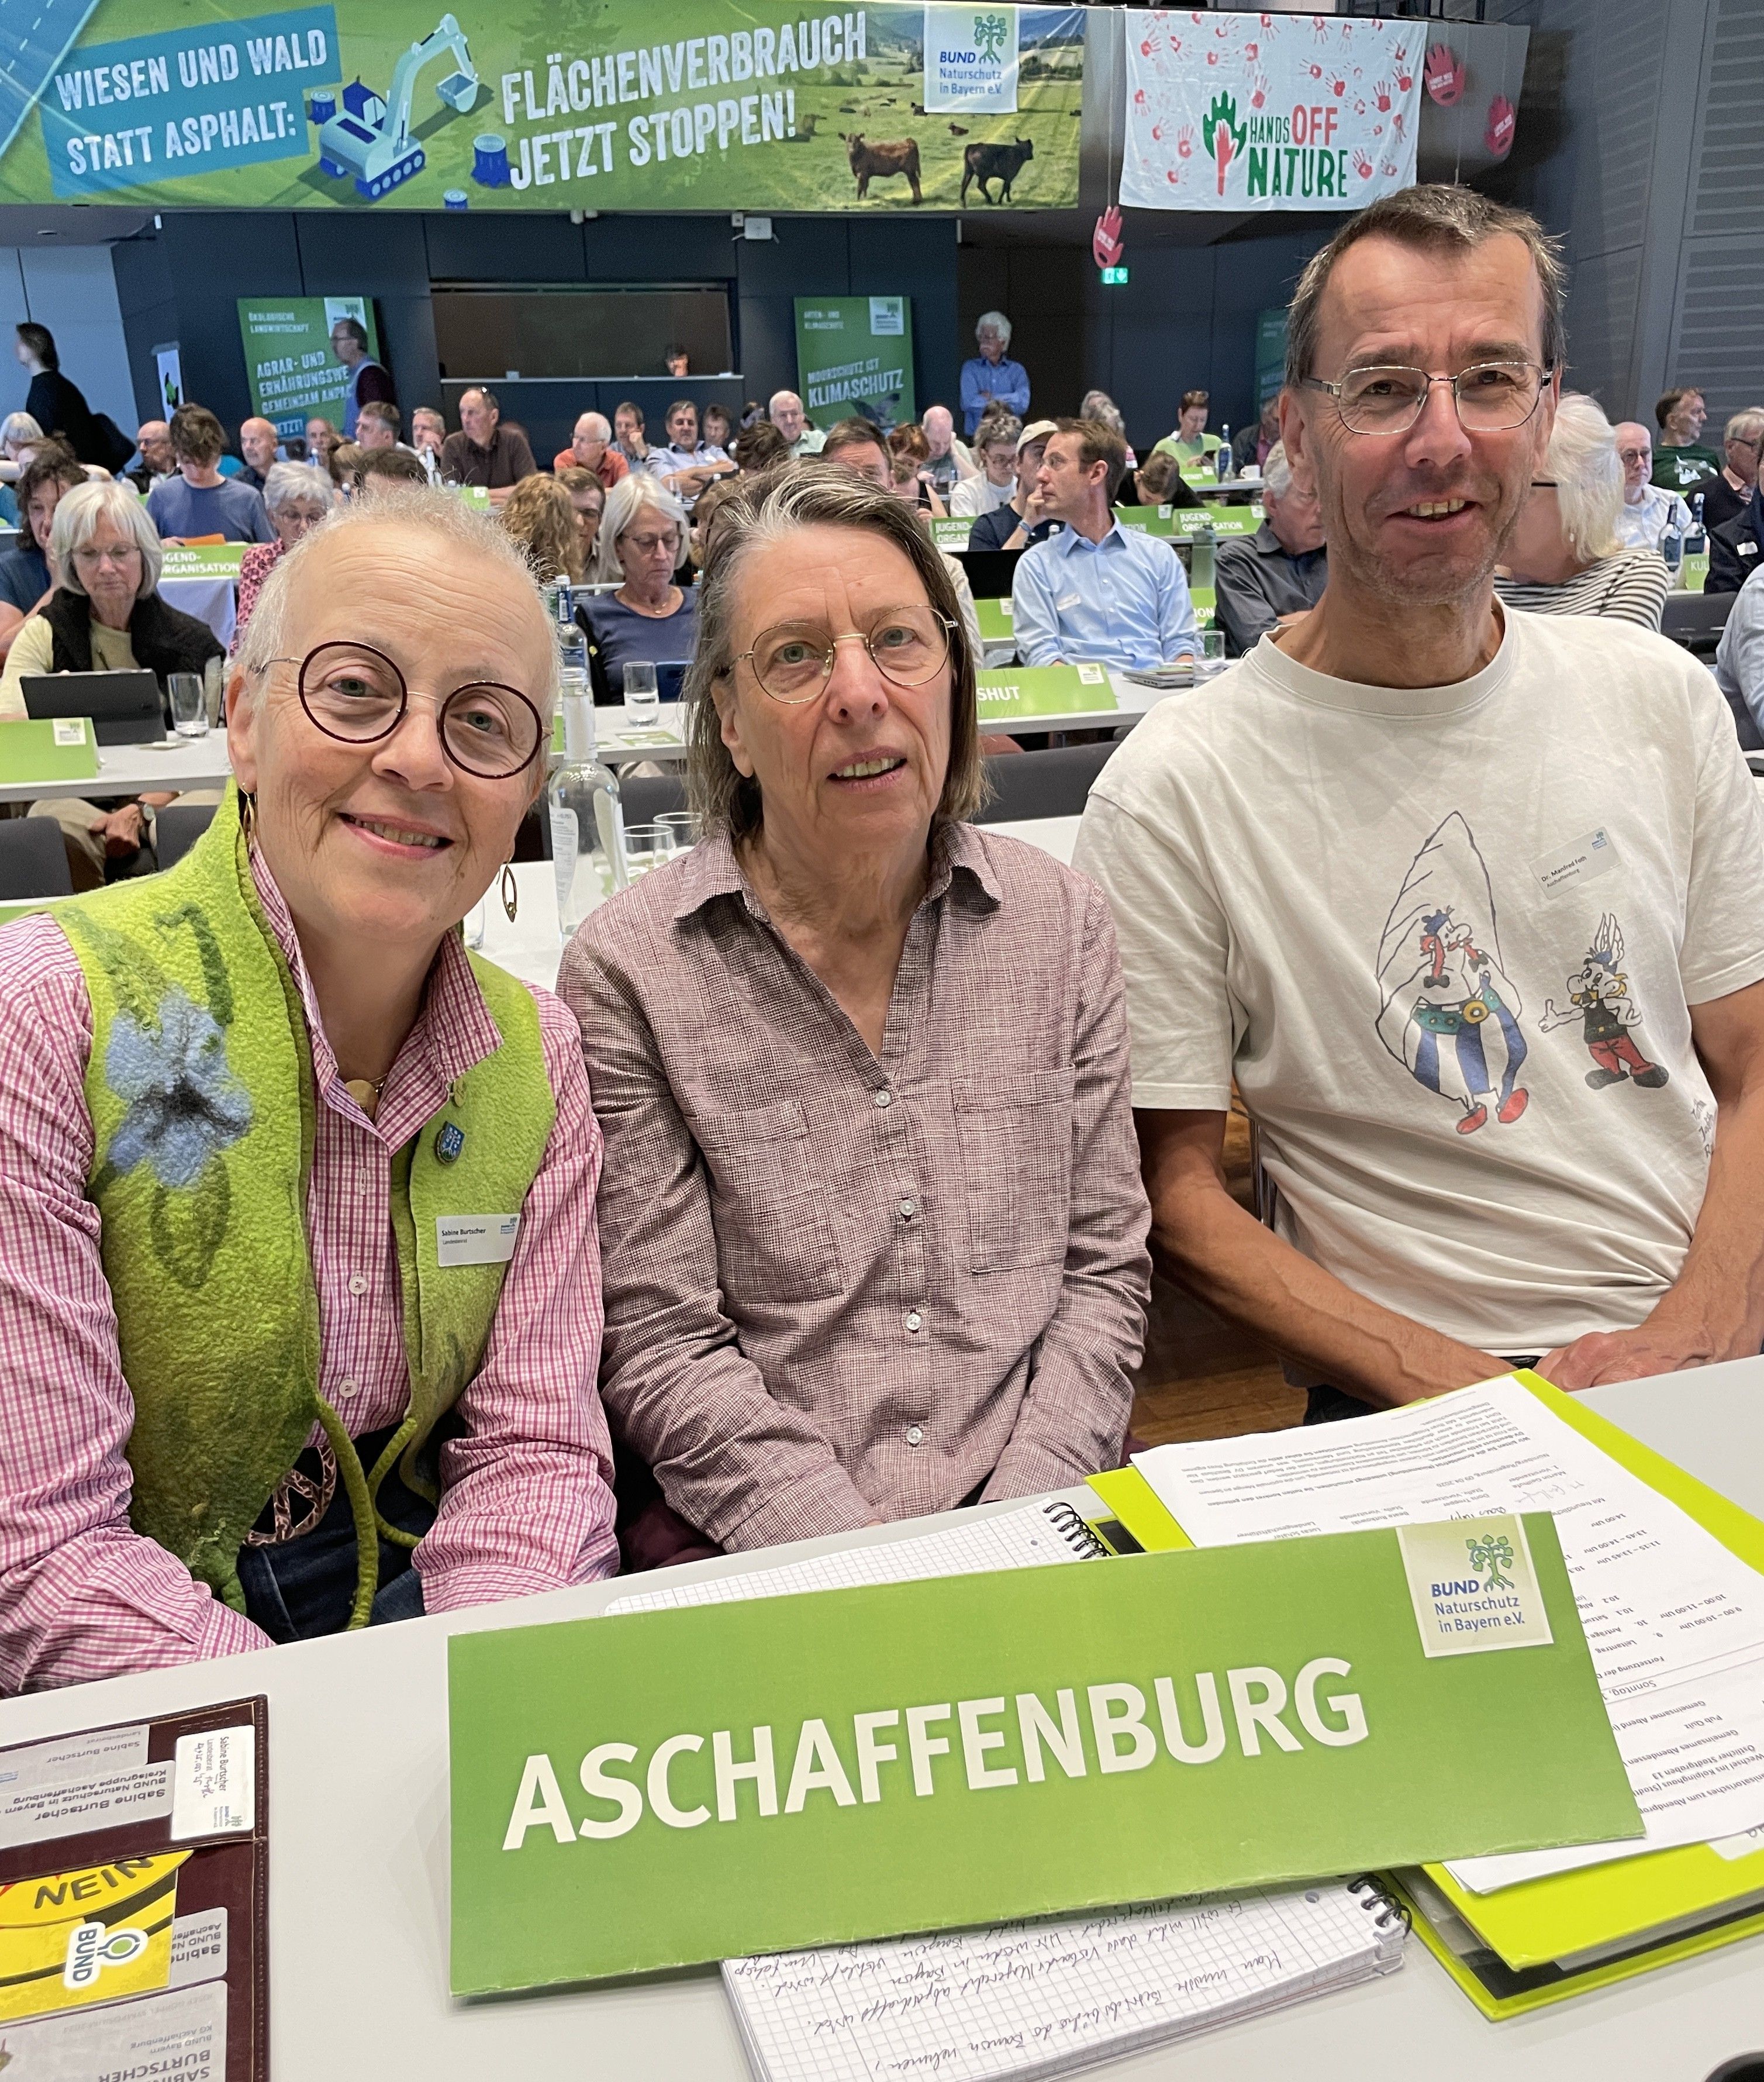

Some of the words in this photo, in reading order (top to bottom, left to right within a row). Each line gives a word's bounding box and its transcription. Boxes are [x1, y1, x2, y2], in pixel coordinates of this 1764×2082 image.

[939, 51, 976, 64] BUND
[55, 56, 170, 111] WIESEN
[179, 44, 239, 88] UND
[247, 29, 327, 75] WALD
[500, 11, 867, 125] FLÄCHENVERBRAUCH
[939, 68, 1002, 81] Naturschutz
[939, 84, 948, 95] in
[951, 83, 985, 97] Bayern
[1250, 116, 1290, 143] HANDS
[1292, 104, 1338, 146] OFF
[67, 125, 153, 175] STATT
[165, 102, 296, 160] ASPHALT:
[510, 122, 616, 190] JETZT
[629, 90, 796, 167] STOPPEN!
[1248, 148, 1348, 198] NATURE
[257, 357, 298, 378] AGRAR-
[301, 351, 325, 368] UND
[808, 369, 903, 408] KLIMASCHUTZ
[262, 391, 319, 414] GEMEINSAM
[1180, 512, 1215, 523] JUGEND-
[935, 522, 972, 533] JUGEND-
[1551, 860, 1575, 876] Manfred
[1508, 1467, 1551, 1482] Vorsitzender
[1541, 1470, 1566, 1480] Martin
[1420, 1493, 1461, 1504] Vorsitzende
[1339, 1509, 1379, 1519] Vorsitzende
[1604, 1513, 1626, 1522] 14:00
[1237, 1521, 1316, 1537] Landesgeschäftsführer
[1597, 1539, 1620, 1549] 14:00
[1638, 1540, 1661, 1550] 11:15
[1611, 1549, 1632, 1559] 13:45
[1431, 1580, 1480, 1598] BUND
[1434, 1597, 1520, 1616] Naturschutz
[1601, 1595, 1620, 1603] 10.2
[1703, 1594, 1726, 1604] 10:00
[1615, 1607, 1634, 1615] 10.1
[1675, 1604, 1697, 1614] 11:00
[1722, 1607, 1742, 1615] 9:00
[1438, 1618, 1452, 1633] in
[1455, 1615, 1502, 1632] Bayern
[1504, 1611, 1525, 1628] e.V.
[1694, 1615, 1717, 1625] 10:00
[1590, 1626, 1621, 1638] Anträge
[1594, 1639, 1637, 1653] Leitantrag
[1617, 1656, 1664, 1671] Fortsetzung
[1608, 1676, 1656, 1695] Sonntag,
[1649, 1701, 1706, 1720] Gemeinsamer
[1620, 1717, 1648, 1729] Abend
[1683, 1720, 1704, 1729] Quiz
[1704, 1715, 1722, 1723] Pub
[103, 1740, 140, 1752] Sabine
[219, 1736, 229, 1758] Sabine
[1679, 1729, 1738, 1750] Gemeinsames
[46, 1748, 100, 1763] Burtscher
[205, 1738, 213, 1771] Landesbeirat
[502, 1657, 1369, 1852] ASCHAFFENBURG
[1627, 1747, 1679, 1764] Abendessen
[1718, 1745, 1755, 1759] Östlicher
[1663, 1756, 1717, 1775] Stadtgraben
[1729, 1753, 1764, 1769] Wechsel
[99, 1769, 166, 1787] Kreisgruppe
[133, 1777, 166, 1788] BUND
[219, 1759, 229, 1791] Burtscher
[1651, 1771, 1663, 1780] 13
[1662, 1769, 1715, 1787] Kolpinghaus
[13, 1783, 96, 1804] Aschaffenburg
[61, 1784, 129, 1802] Naturschutz
[115, 1788, 165, 1804] Sabine
[1686, 1792, 1706, 1801] zum
[5, 1801, 44, 1814] Bayern
[34, 1800, 109, 1821] Burtscher
[34, 1857, 154, 1909] NEIN
[187, 1931, 220, 1946] BUND
[73, 1928, 98, 1981] BUND
[199, 2024, 212, 2033] KG
[130, 2028, 198, 2050] Aschaffenburg
[184, 2034, 212, 2046] BUND
[149, 2042, 182, 2055] Bayern
[98, 2049, 210, 2082] BURTSCHER
